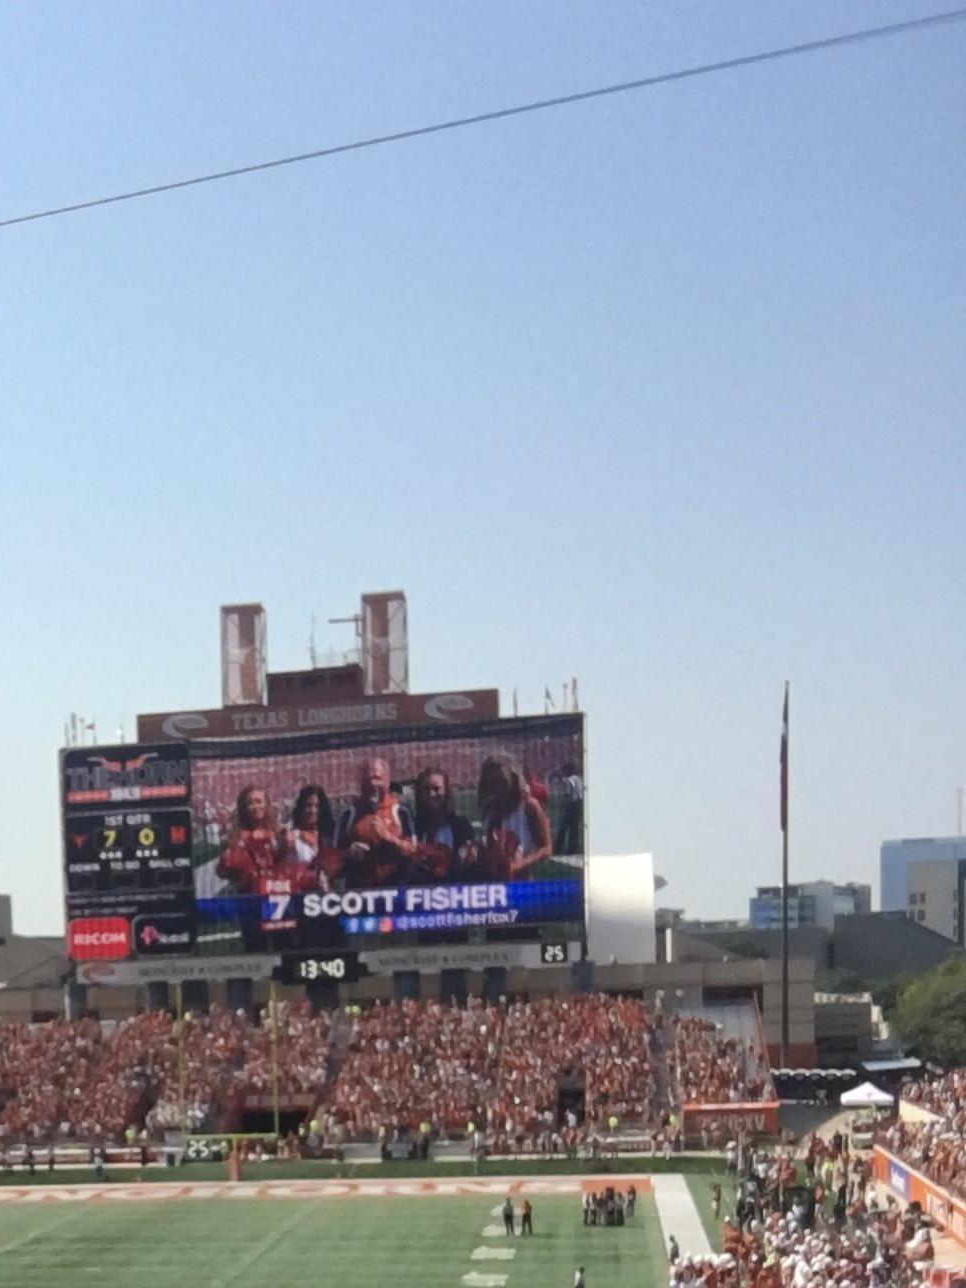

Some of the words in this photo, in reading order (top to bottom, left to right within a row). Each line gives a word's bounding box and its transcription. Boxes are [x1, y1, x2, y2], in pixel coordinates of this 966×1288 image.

[232, 710, 289, 731] TEXAS
[298, 701, 398, 727] LONGHORNS
[103, 829, 118, 848] 7
[138, 827, 155, 846] 0
[268, 894, 292, 921] 7
[303, 889, 398, 918] SCOTT
[405, 883, 508, 911] FISHER
[73, 931, 127, 946] RICOH
[544, 944, 564, 962] 25
[188, 1139, 210, 1158] 25
